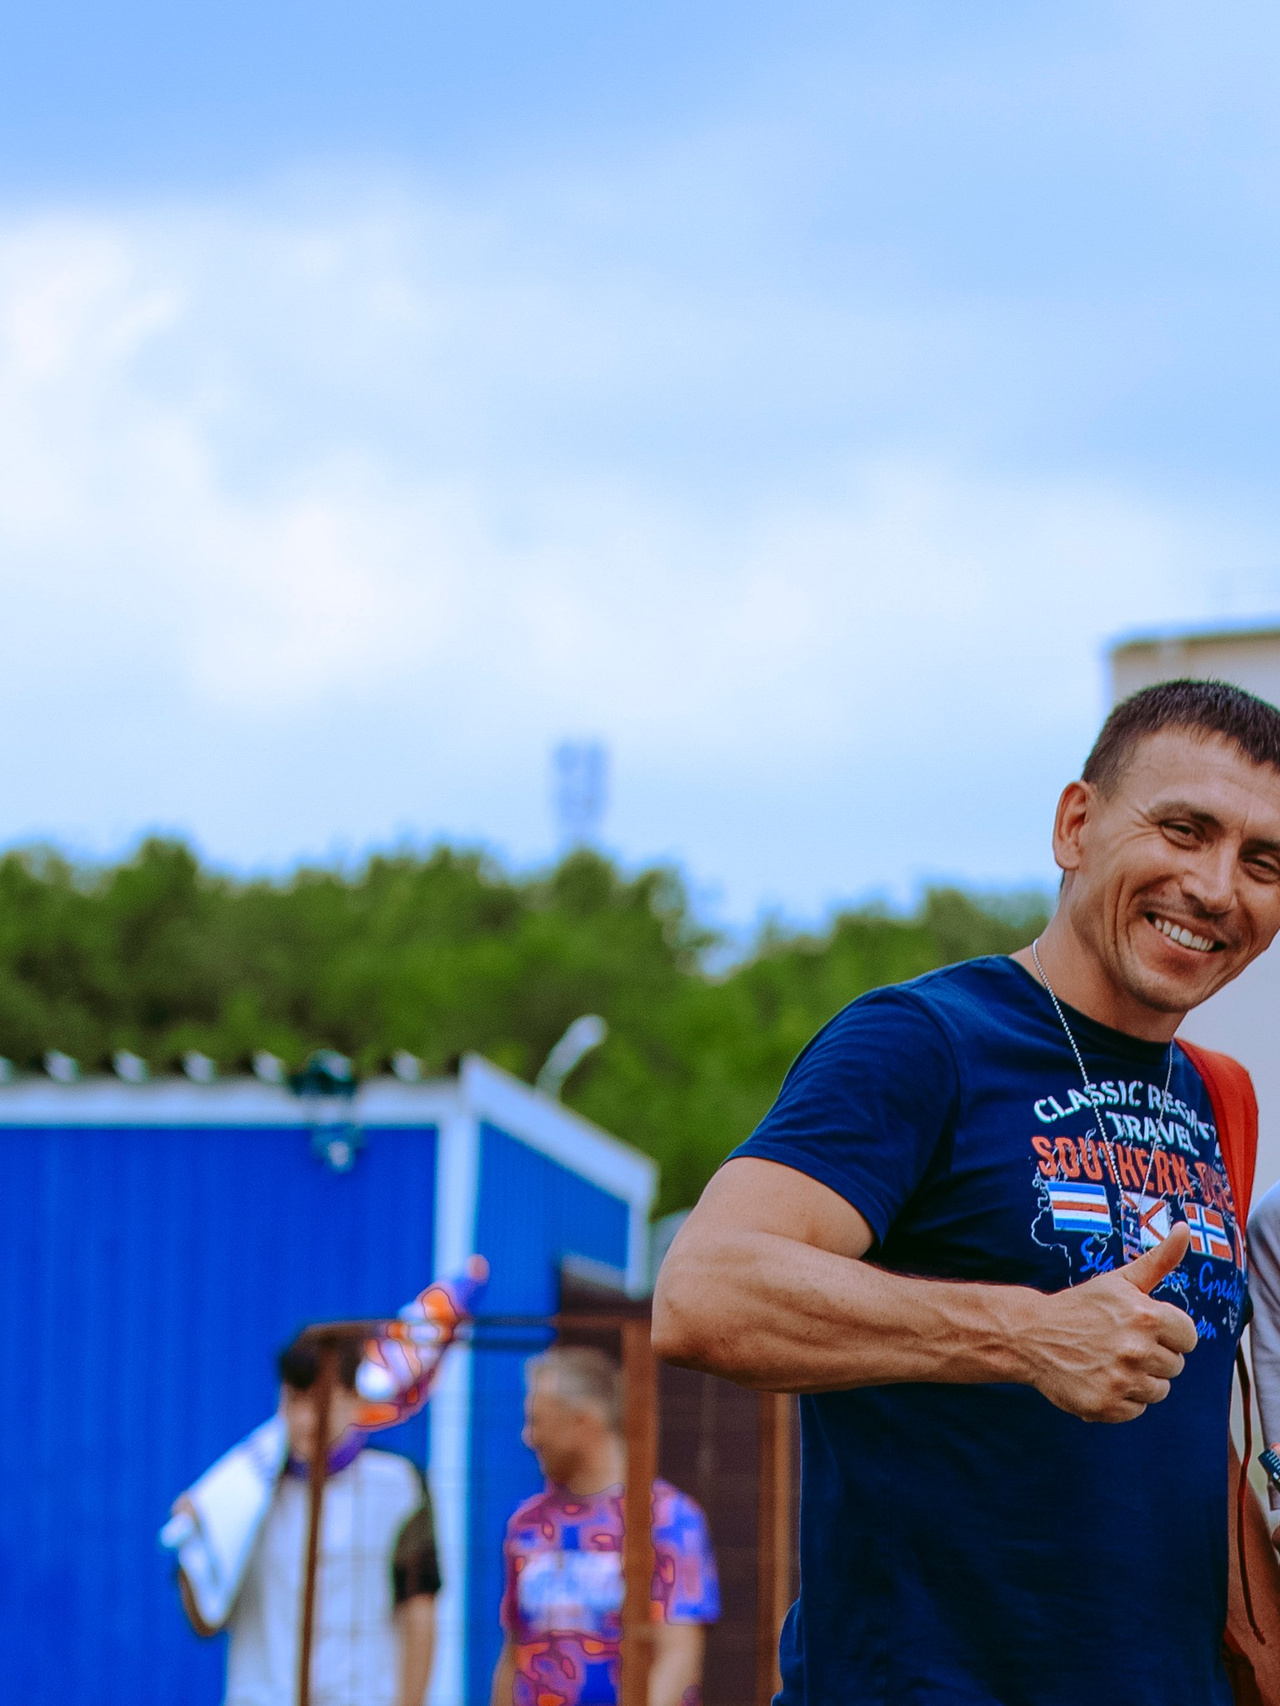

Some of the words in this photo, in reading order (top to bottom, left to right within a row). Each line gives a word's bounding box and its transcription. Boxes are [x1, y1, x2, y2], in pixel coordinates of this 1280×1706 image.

[1033, 1080, 1144, 1124] CLASSIC
[1105, 1110, 1200, 1157] TRAVEL
[1031, 1136, 1194, 1199] SOUTHERN
